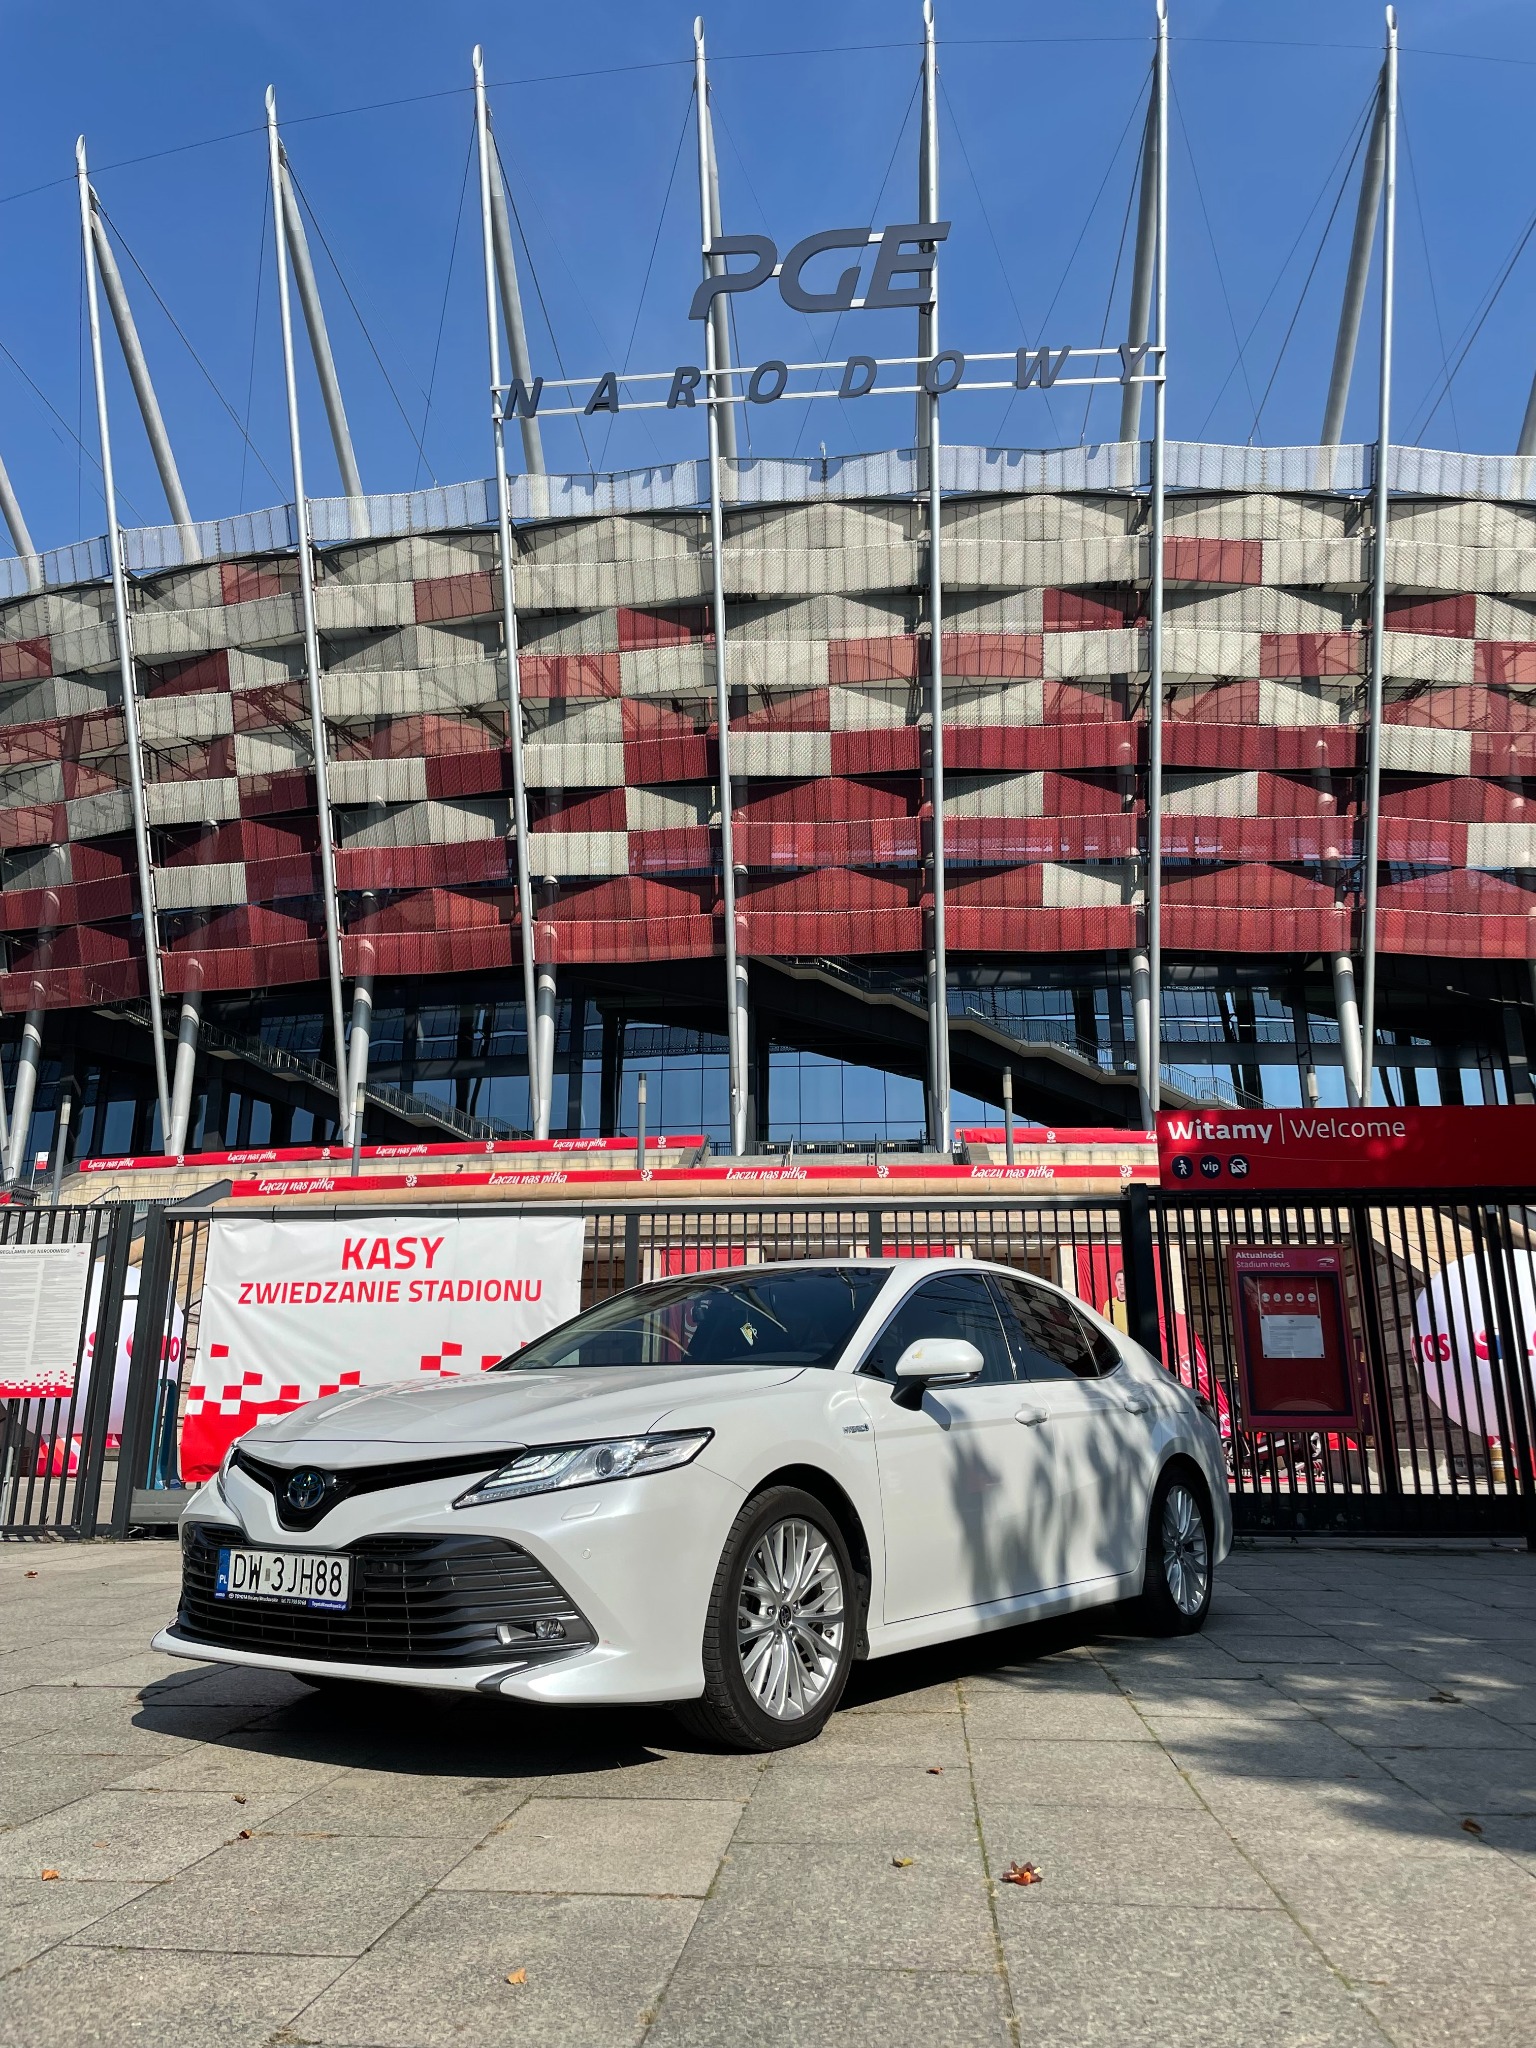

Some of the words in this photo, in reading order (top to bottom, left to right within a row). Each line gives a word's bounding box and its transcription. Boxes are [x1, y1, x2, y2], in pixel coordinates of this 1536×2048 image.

[688, 221, 951, 320] PGE
[503, 342, 1151, 420] NARODOWY
[1167, 1118, 1273, 1144] Witamy
[1290, 1118, 1406, 1139] Welcome
[408, 1144, 428, 1156] piłka
[553, 1140, 574, 1151] Łączy
[587, 1138, 607, 1150] piłka
[759, 1170, 780, 1180] nas
[780, 1166, 808, 1180] piłka
[1005, 1168, 1026, 1178] nas
[1026, 1165, 1055, 1178] piłka
[1202, 1161, 1219, 1172] vip
[488, 1172, 520, 1185] Łączy
[520, 1174, 541, 1184] nas
[540, 1171, 568, 1184] piłka
[258, 1180, 289, 1195] Łączy
[289, 1180, 308, 1192] nas
[307, 1177, 335, 1194] piłka
[341, 1237, 445, 1270] KASY
[1235, 1251, 1284, 1259] Aktualności
[238, 1280, 401, 1304] ZWIEDZANIE
[408, 1279, 542, 1302] STADIONU
[219, 1574, 227, 1584] PL
[233, 1554, 263, 1590] DW
[271, 1557, 342, 1597] 3JH88
